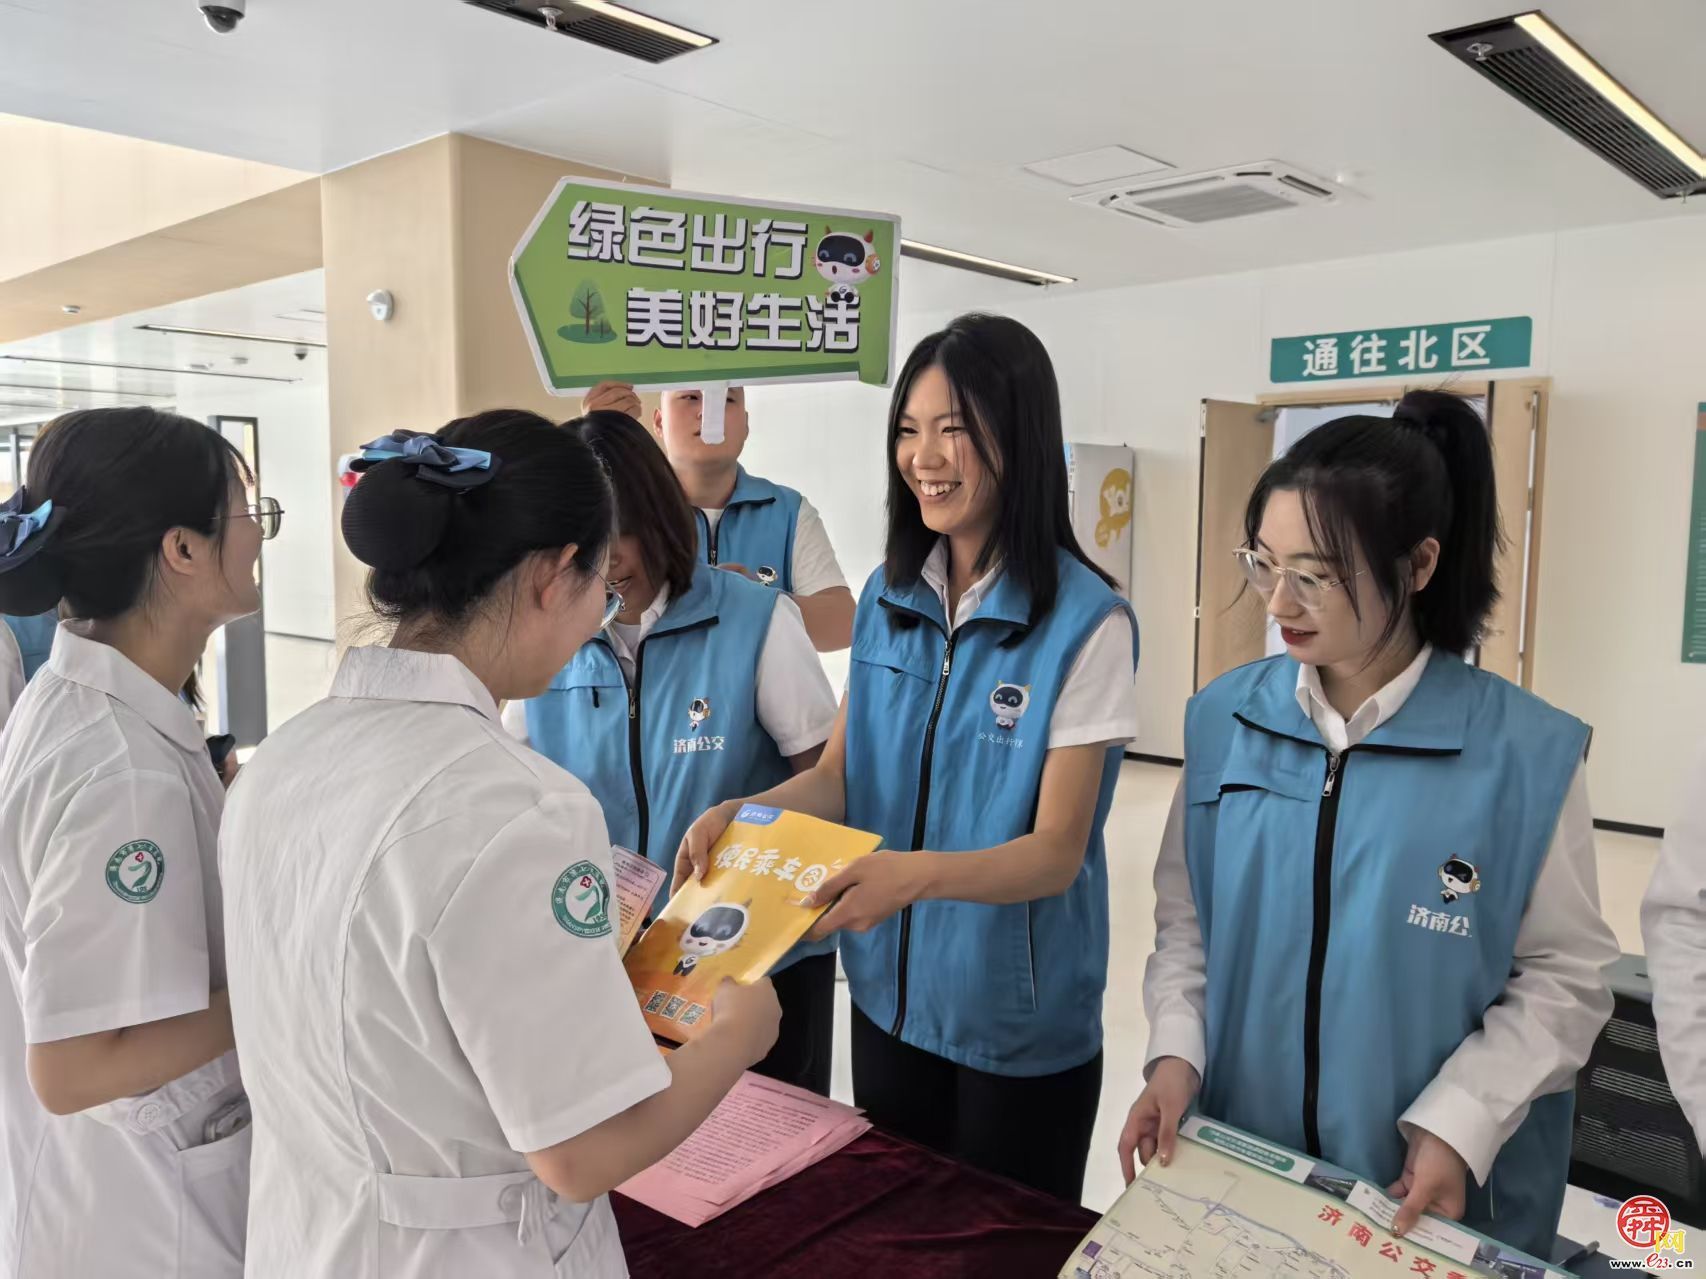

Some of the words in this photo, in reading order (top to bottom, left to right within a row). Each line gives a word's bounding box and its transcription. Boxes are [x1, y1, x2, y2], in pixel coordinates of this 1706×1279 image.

[567, 200, 809, 280] 绿色出行
[625, 286, 861, 354] 美好生活
[1302, 324, 1492, 377] 通往北区
[1406, 903, 1473, 938] 济南公
